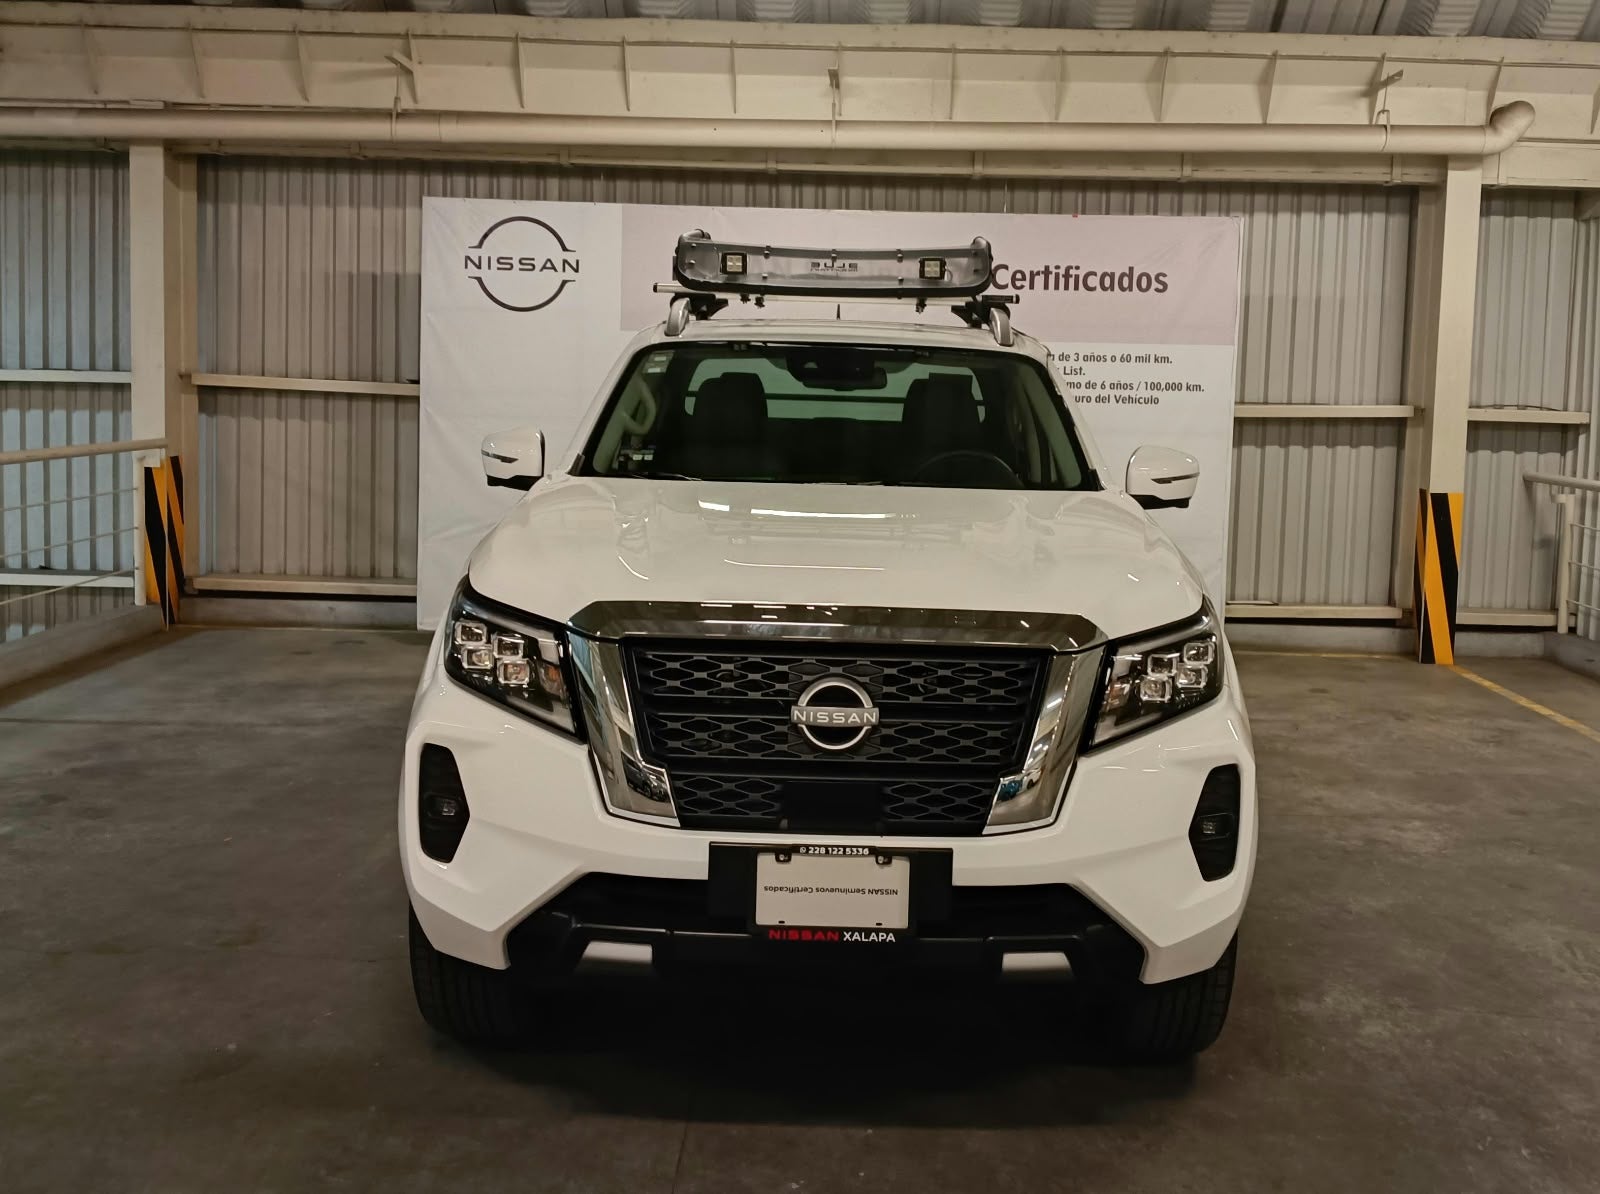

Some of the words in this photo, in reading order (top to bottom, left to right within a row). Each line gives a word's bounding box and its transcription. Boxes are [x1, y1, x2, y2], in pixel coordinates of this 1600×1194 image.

[464, 255, 580, 273] NISSAN
[991, 263, 1169, 293] Certificados
[1058, 352, 1071, 362] de
[1073, 352, 1080, 362] 3
[1082, 352, 1107, 363] años
[1110, 355, 1117, 363] o
[1119, 353, 1132, 363] 60
[1134, 353, 1151, 364] mil
[1153, 353, 1173, 364] km.
[1063, 366, 1086, 376] List.
[1066, 381, 1082, 390] mo
[1084, 380, 1097, 390] de
[1100, 380, 1107, 390] 6
[1109, 380, 1134, 391] años
[1144, 381, 1183, 392] 100,000
[1185, 382, 1205, 392] km.
[1074, 395, 1092, 404] uro
[1094, 394, 1111, 404] del
[1113, 394, 1160, 405] Vehículo
[793, 710, 876, 724] NISSAN
[808, 846, 826, 855] 228
[827, 847, 844, 855] 122
[845, 847, 870, 856] 5336
[763, 885, 814, 894] Certificados
[815, 887, 866, 895] Seminuevos
[867, 888, 898, 896] NISSAN
[768, 929, 840, 942] NISSAN
[843, 931, 896, 943] XALAPA
